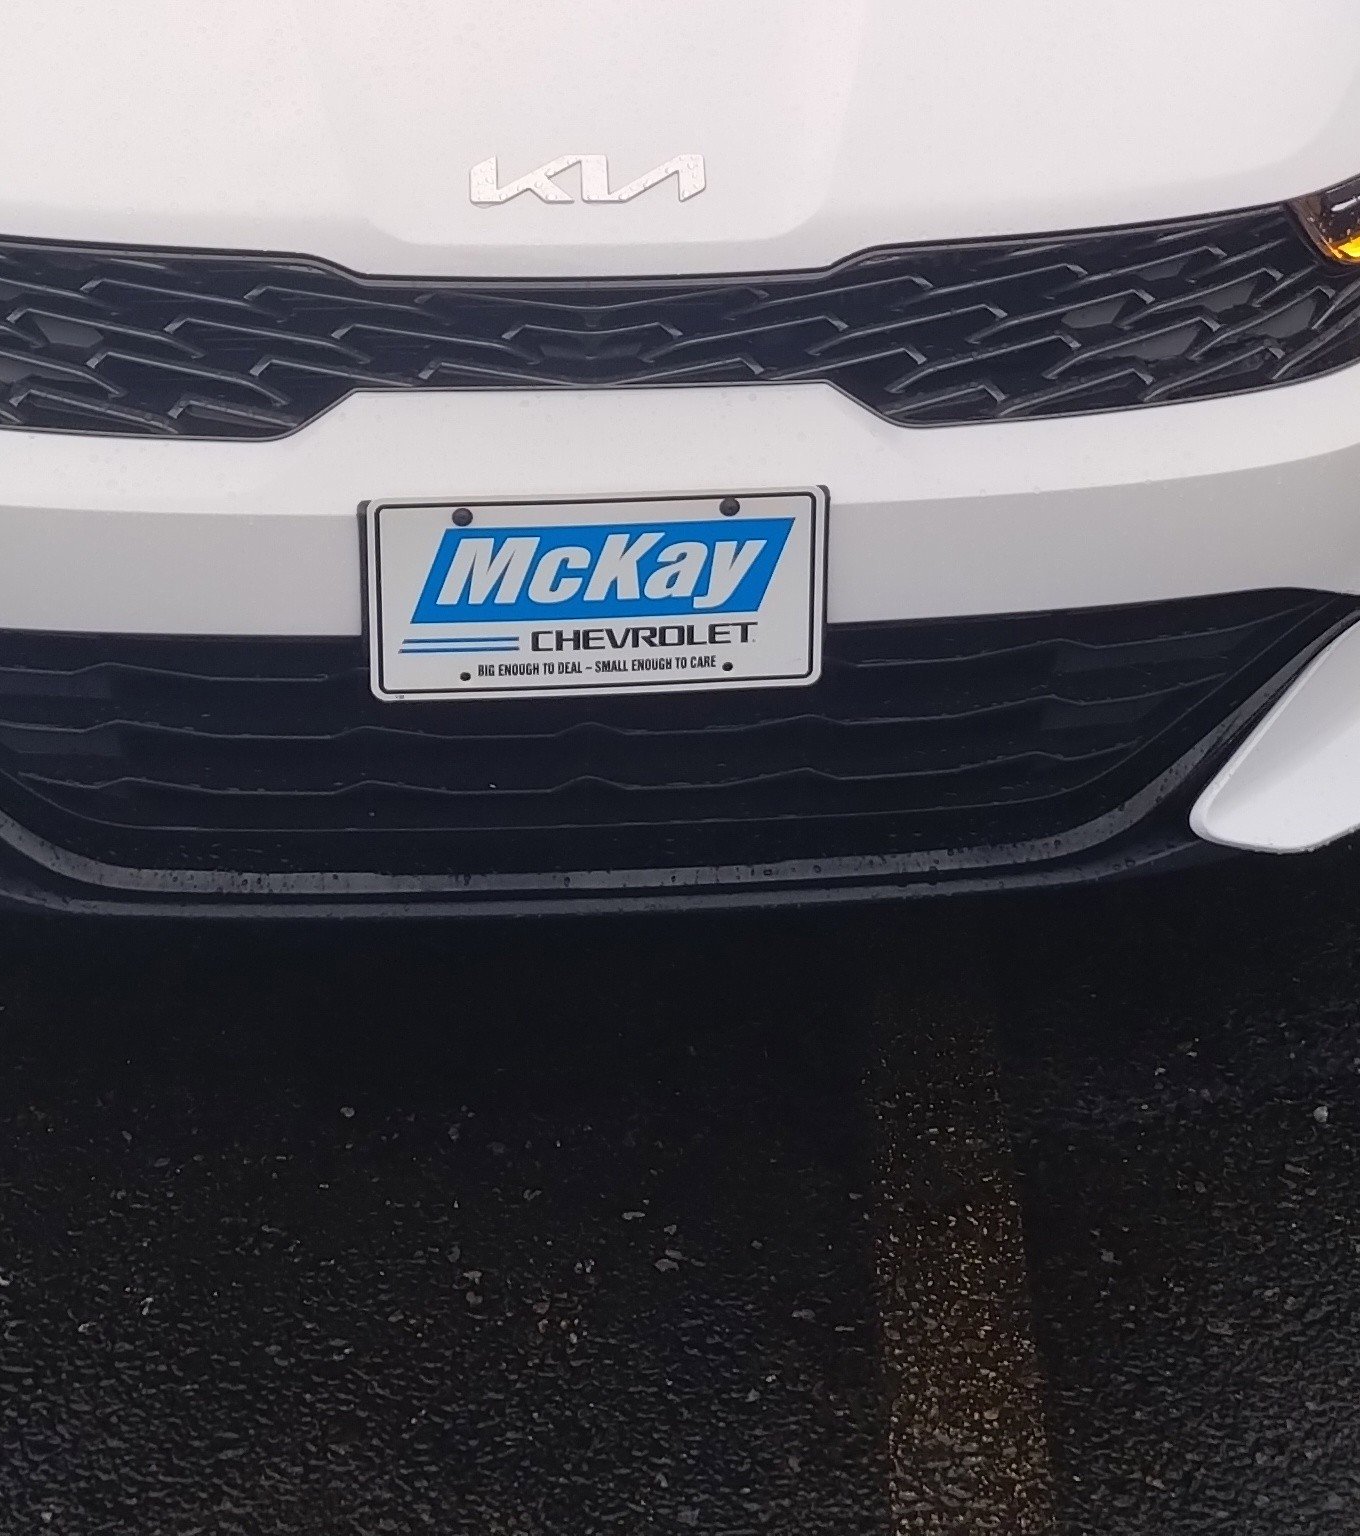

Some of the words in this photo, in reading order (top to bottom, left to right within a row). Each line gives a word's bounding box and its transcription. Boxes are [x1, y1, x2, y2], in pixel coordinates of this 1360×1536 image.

[469, 154, 706, 203] KIA
[437, 532, 768, 609] McKay
[531, 621, 758, 652] CHEVROLET
[478, 664, 495, 676] BIG
[498, 663, 539, 676] ENOUGH
[543, 662, 555, 674] TO
[558, 661, 583, 675] DEAL
[595, 660, 628, 673] SMALL
[631, 658, 672, 671] ENOUGH
[675, 656, 688, 669] TO
[690, 655, 717, 668] CARE
